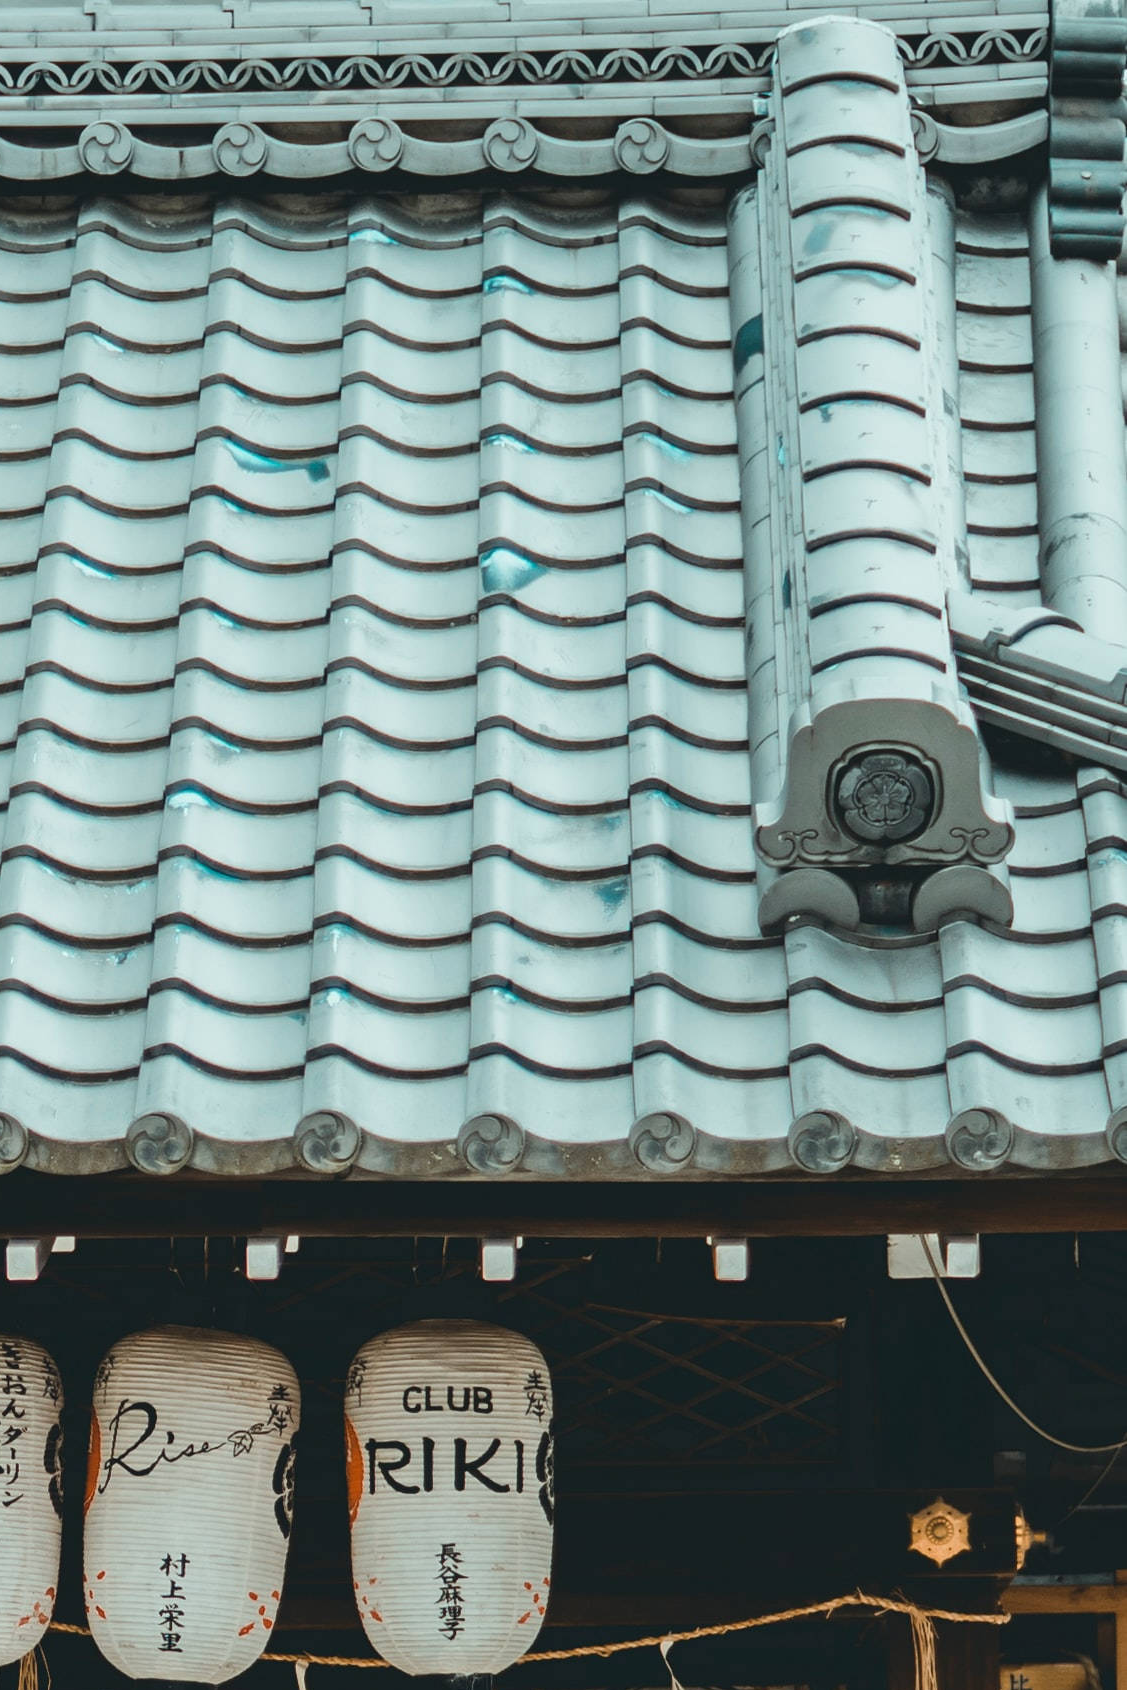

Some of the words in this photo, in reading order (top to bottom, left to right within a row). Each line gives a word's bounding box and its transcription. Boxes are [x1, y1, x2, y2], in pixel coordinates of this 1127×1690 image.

[402, 1385, 494, 1414] CLUB
[364, 1436, 525, 1495] RIKI
[157, 1552, 191, 1653] 村上栄里
[434, 1542, 469, 1641] 長谷麻理子
